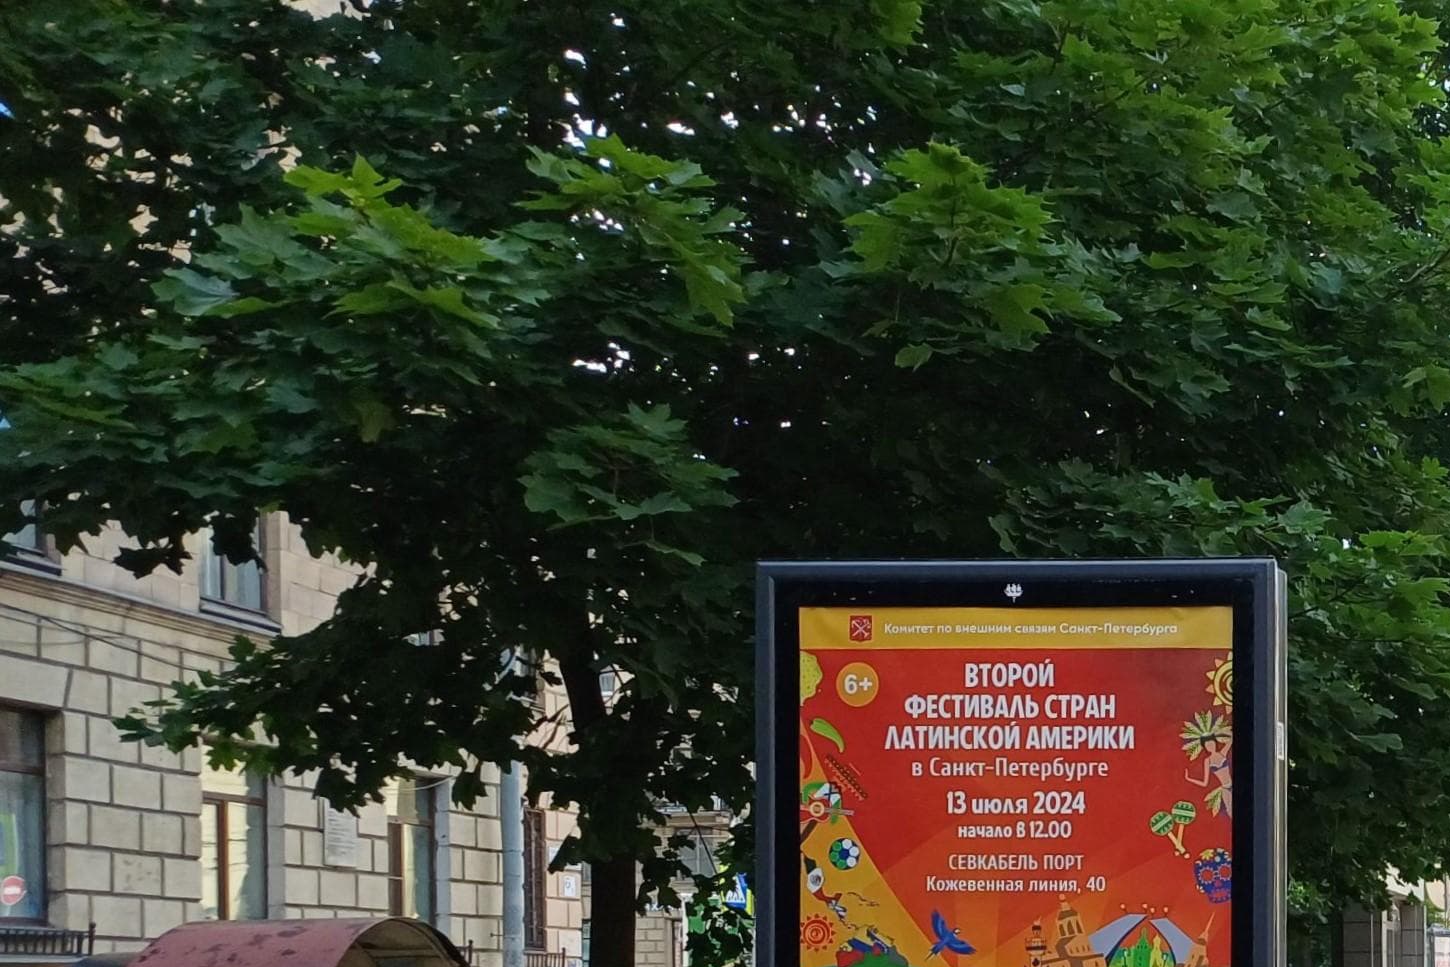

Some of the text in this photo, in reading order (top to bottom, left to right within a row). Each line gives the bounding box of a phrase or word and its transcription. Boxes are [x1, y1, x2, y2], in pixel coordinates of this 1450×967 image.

[884, 623, 1177, 637] Комитет по внешним связям Санкт-Петербурга
[843, 673, 873, 695] 6+
[964, 659, 1055, 687] ВТОРОЙ
[904, 693, 1116, 719] ФЕСТИВАЛЬ СТРАН
[884, 720, 1135, 750] ЛАТИНСКОЙ АМЕРИКИ
[911, 757, 1109, 781] в Санкт-Петербурге
[947, 791, 1086, 815] 13 июля 2024
[958, 820, 1072, 839] начало в 12.00
[948, 853, 1084, 870] СЕВКАБЕЛЬ ПОРТ
[926, 875, 1106, 894] Кожевенная линия, 40
